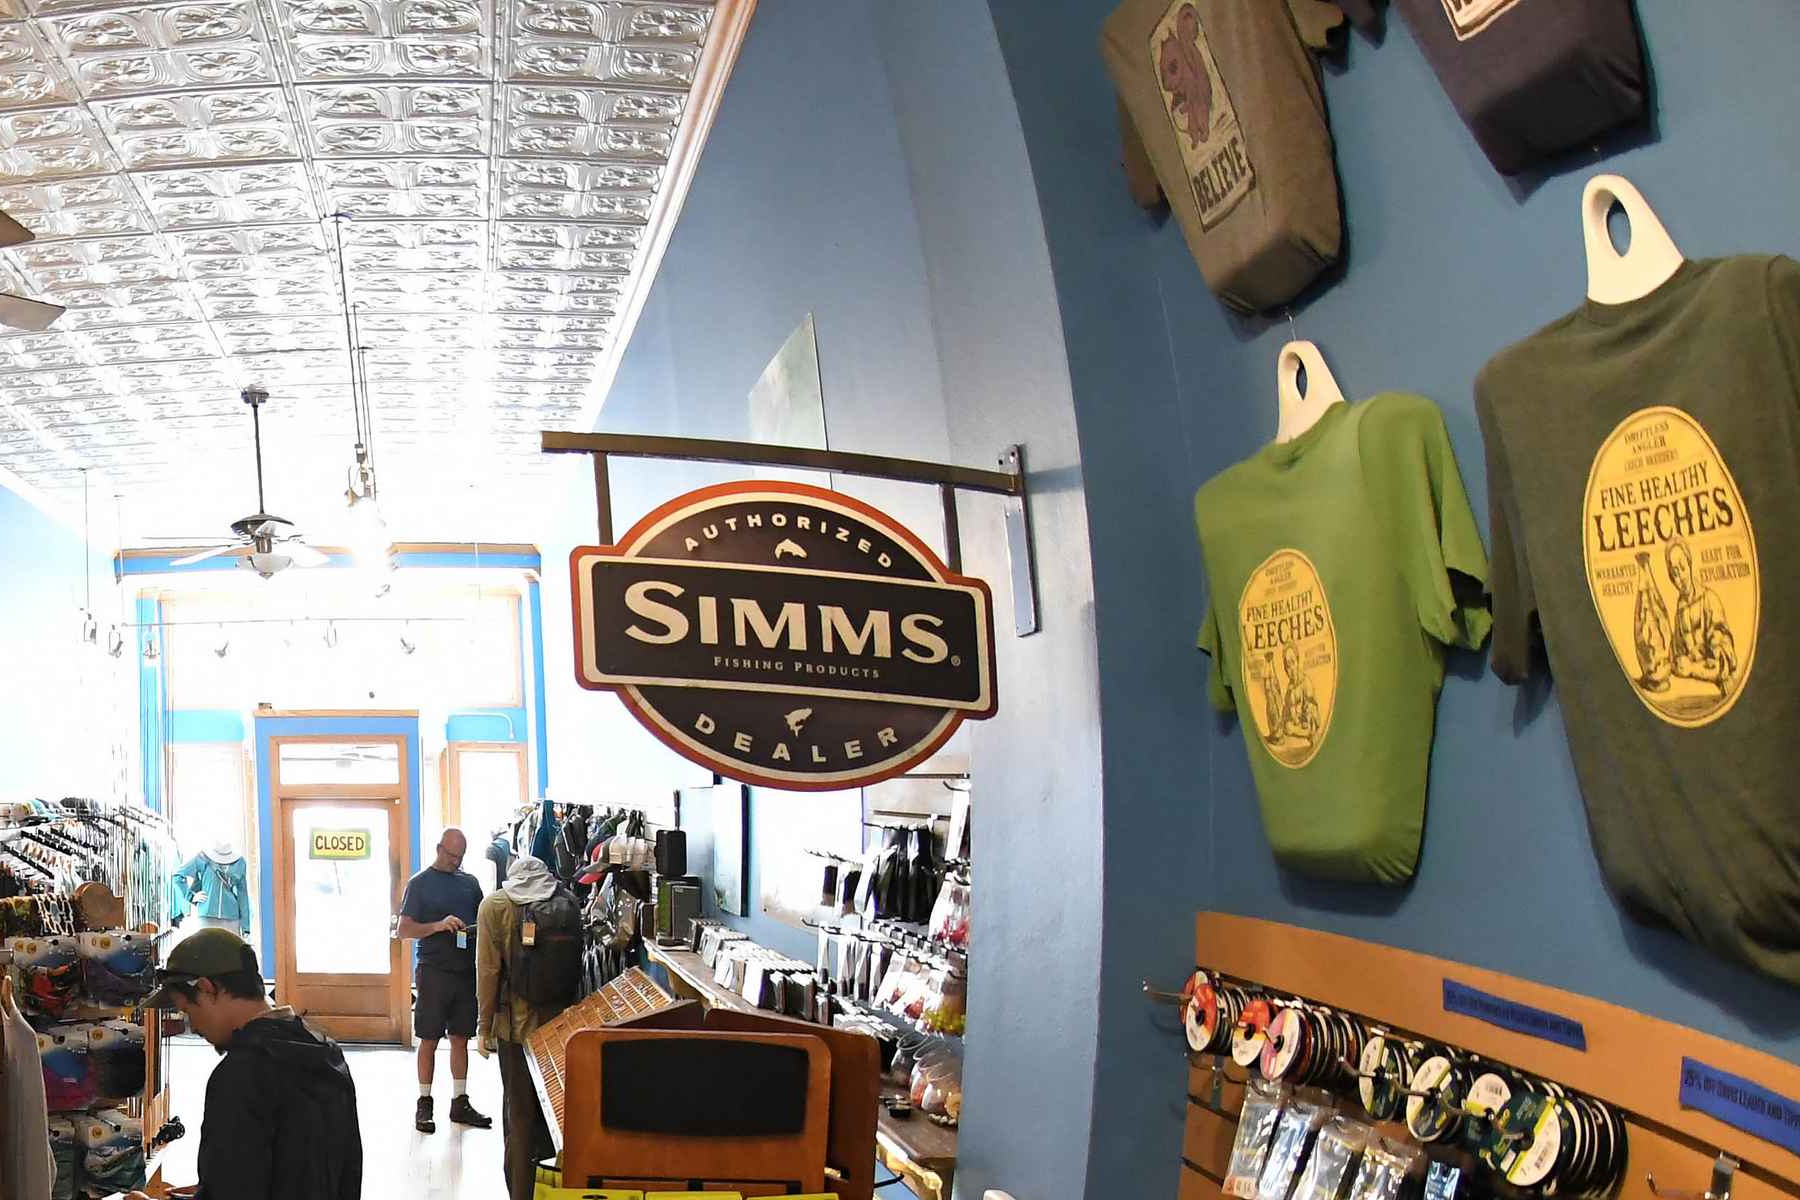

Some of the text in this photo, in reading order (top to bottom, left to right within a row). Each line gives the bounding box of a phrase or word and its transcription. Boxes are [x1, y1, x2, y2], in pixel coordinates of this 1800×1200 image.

[1192, 136, 1247, 214] BELIEVE
[1600, 461, 1710, 510] FINE HEALTHY
[684, 512, 892, 569] AUTHORIZED
[1594, 487, 1734, 552] LEECHES
[623, 580, 950, 666] SIMMS
[1243, 605, 1324, 652] LEECHES
[713, 655, 880, 680] FISHING PRODUCTS
[694, 712, 899, 764] DEALER
[315, 835, 364, 851] CLOSED
